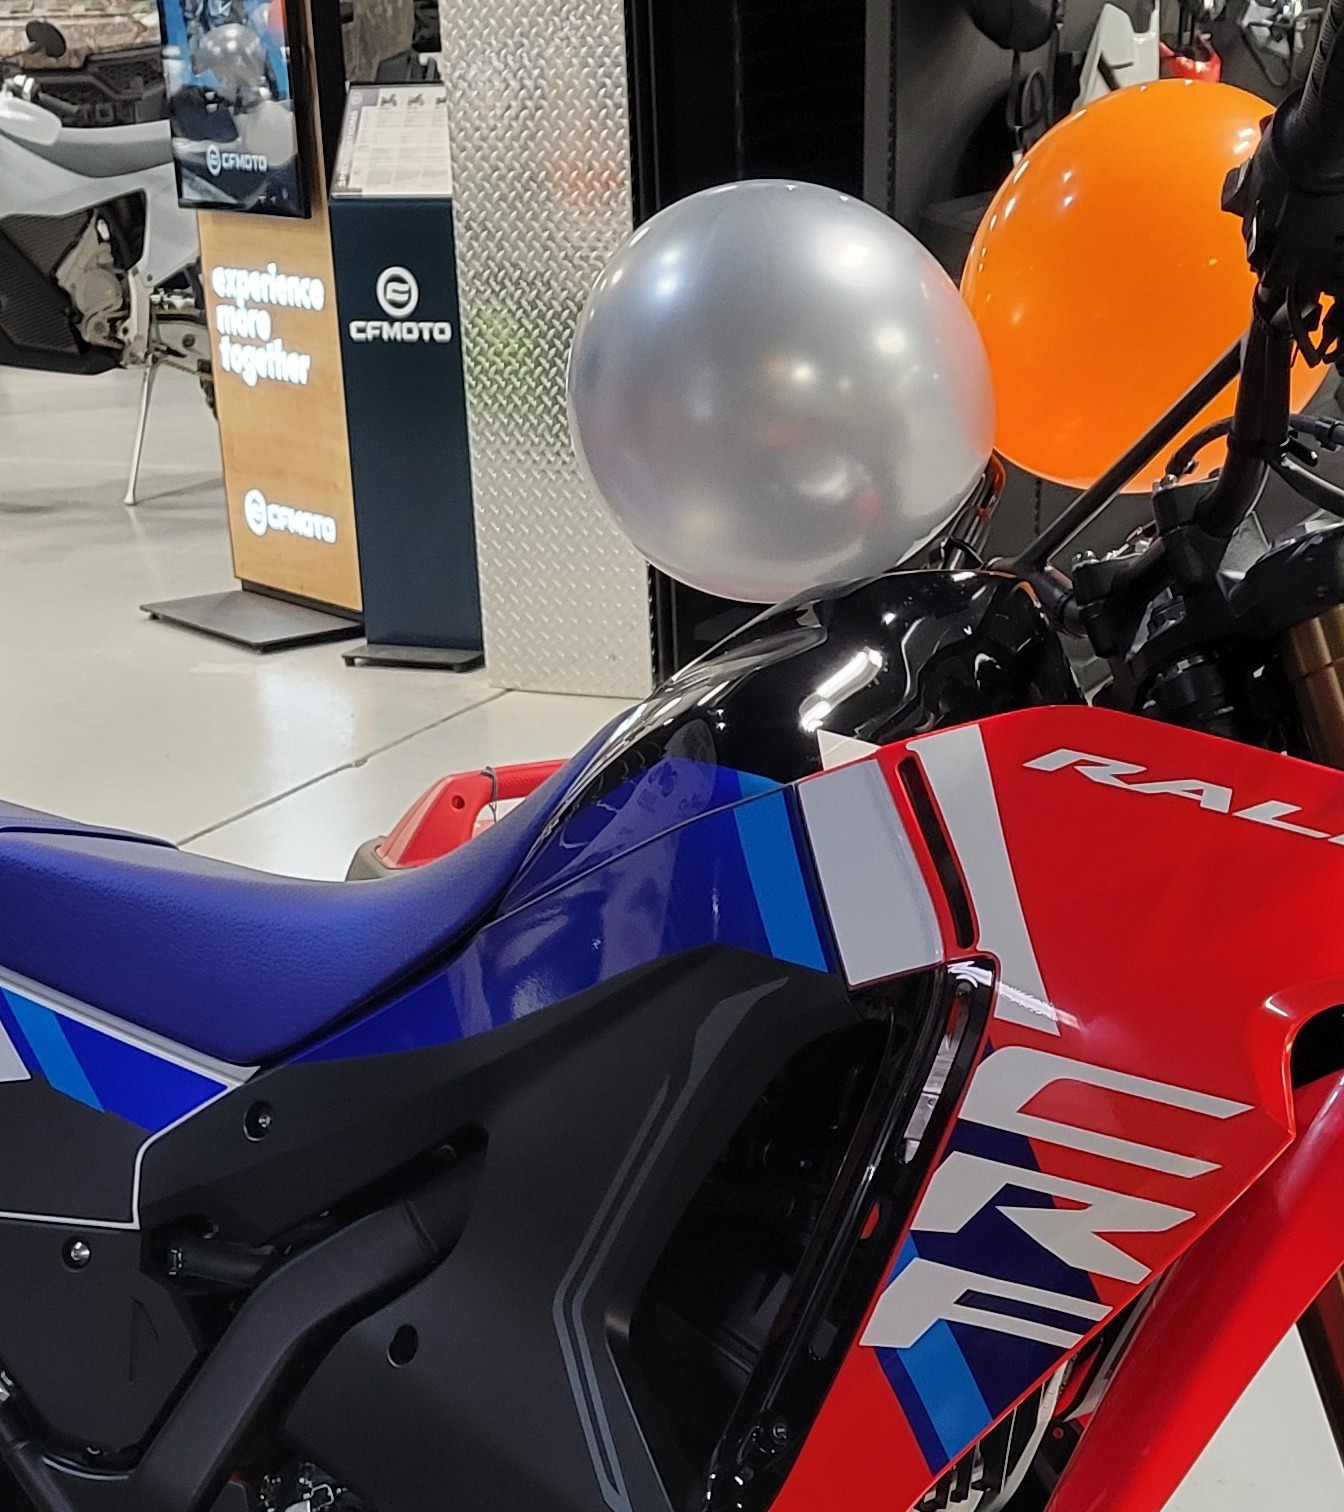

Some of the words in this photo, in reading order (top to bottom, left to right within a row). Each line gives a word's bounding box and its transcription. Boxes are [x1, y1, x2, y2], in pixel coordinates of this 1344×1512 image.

[221, 151, 267, 172] CFMOTO
[211, 261, 325, 311] experience
[215, 304, 272, 342] more
[348, 320, 453, 343] CFMOTO
[219, 335, 311, 387] together
[267, 502, 337, 544] CFMOTO
[859, 1045, 1255, 1350] CRF
